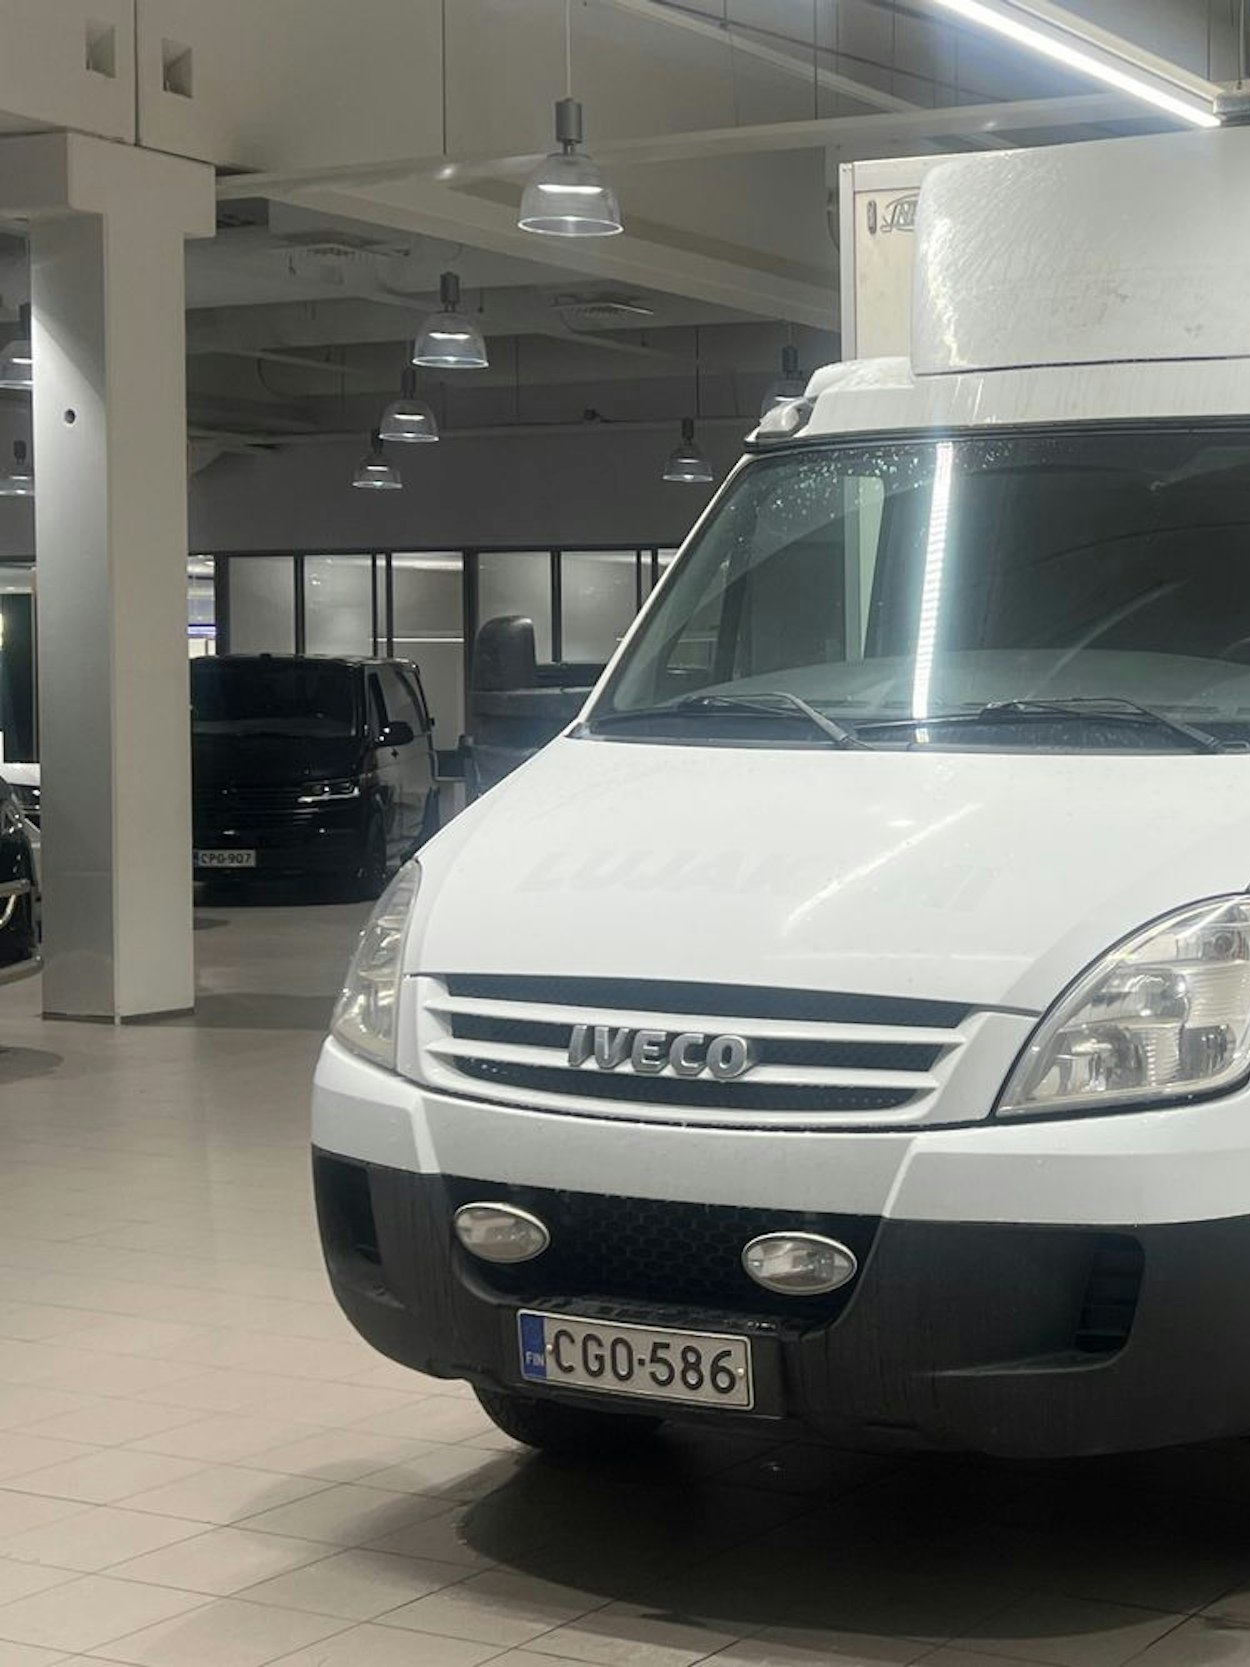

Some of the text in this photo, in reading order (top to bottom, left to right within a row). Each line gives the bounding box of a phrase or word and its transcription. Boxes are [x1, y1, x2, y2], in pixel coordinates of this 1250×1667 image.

[567, 1024, 754, 1080] IVECO
[525, 1350, 545, 1368] FIN
[553, 1329, 737, 1395] CGO-586
